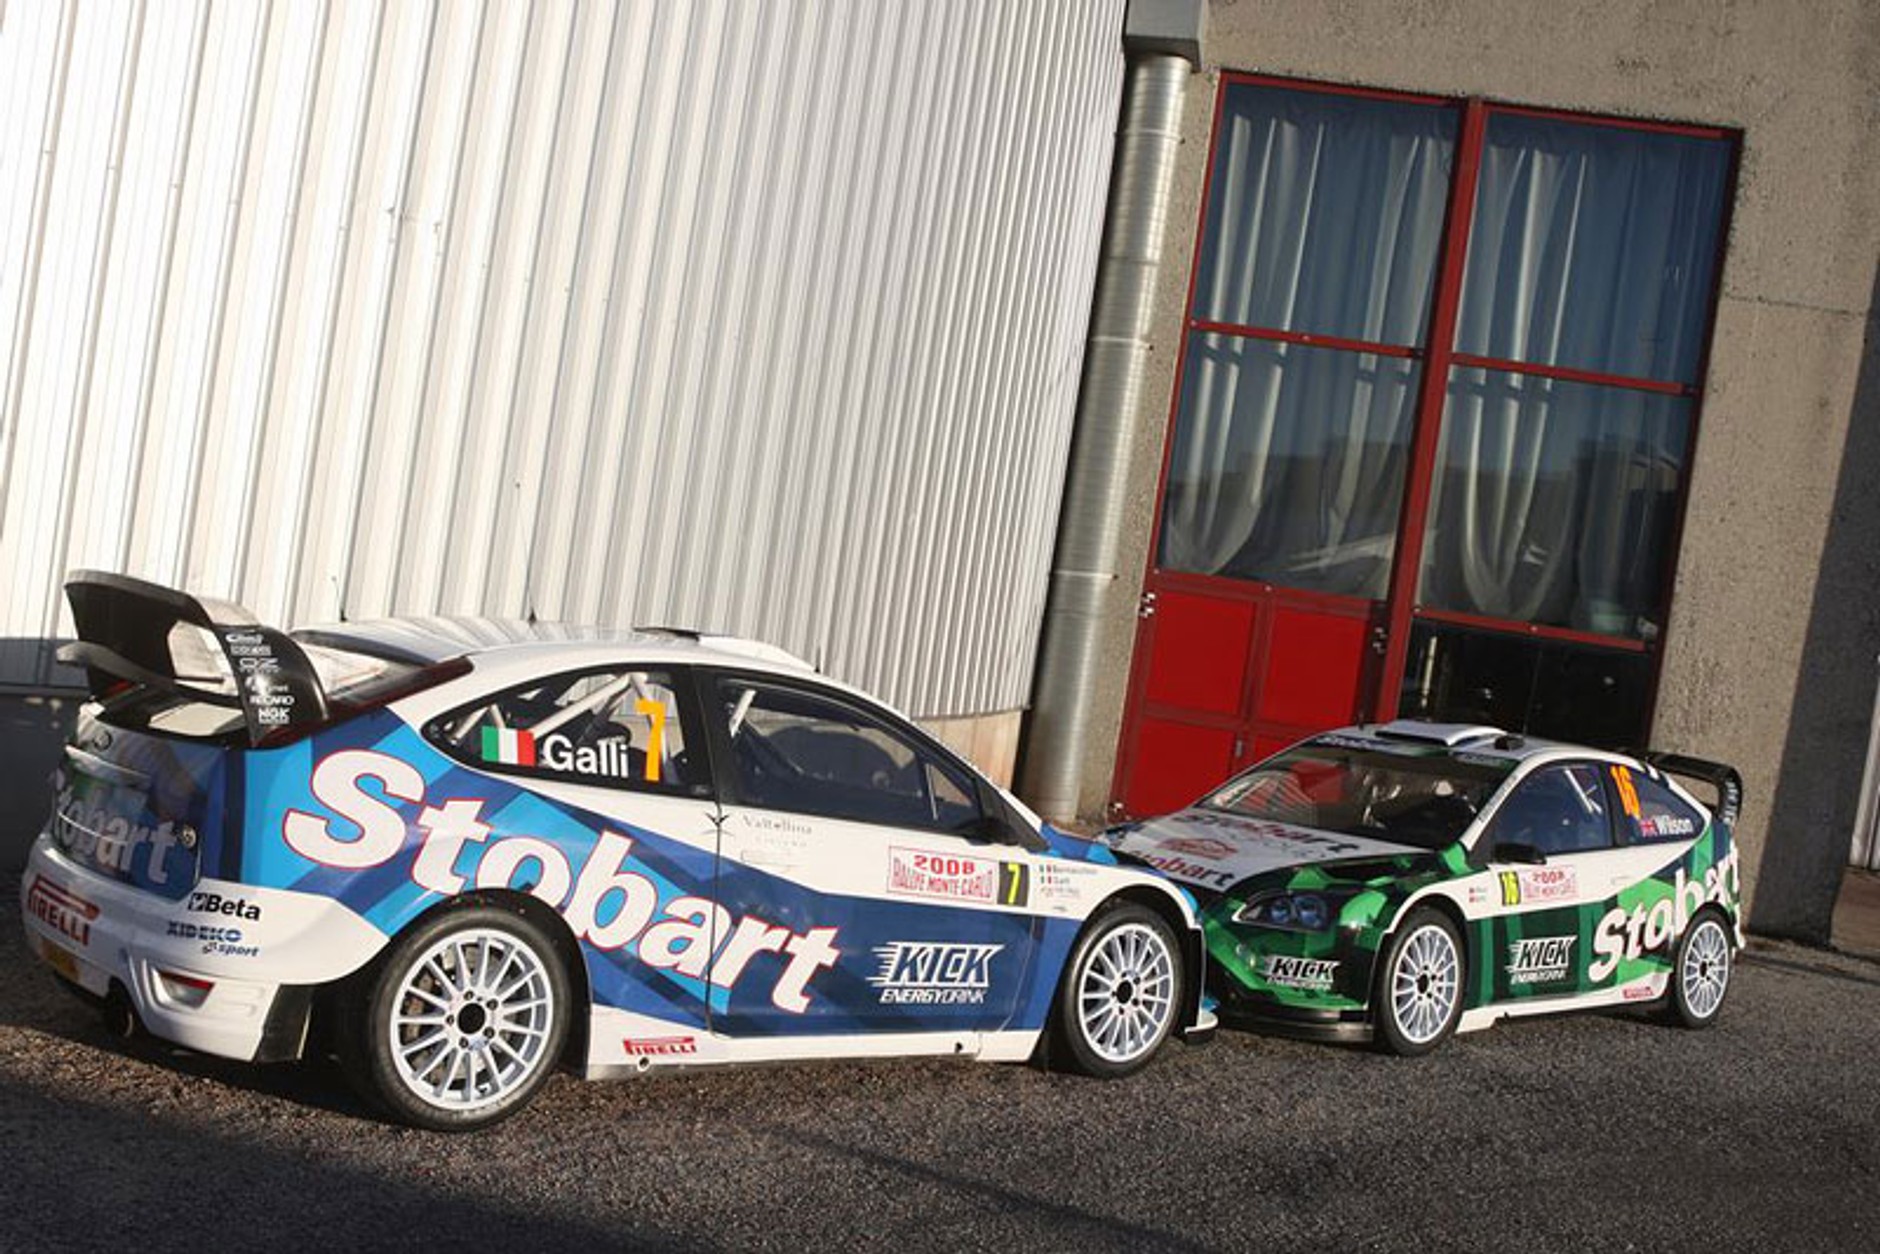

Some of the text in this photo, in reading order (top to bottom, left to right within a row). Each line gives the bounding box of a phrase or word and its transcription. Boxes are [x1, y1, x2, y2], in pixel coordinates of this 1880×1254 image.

[543, 734, 629, 778] Galli
[634, 697, 666, 782] 7
[54, 768, 179, 885] tobart
[1657, 815, 1694, 836] Wilson
[282, 749, 842, 1012] Stobart
[914, 855, 976, 875] 2008
[1008, 863, 1021, 905] 7
[28, 874, 100, 947] PIRELLI
[206, 893, 261, 921] Beta
[884, 943, 1003, 986] KICK
[622, 1037, 697, 1055] PIRELLI
